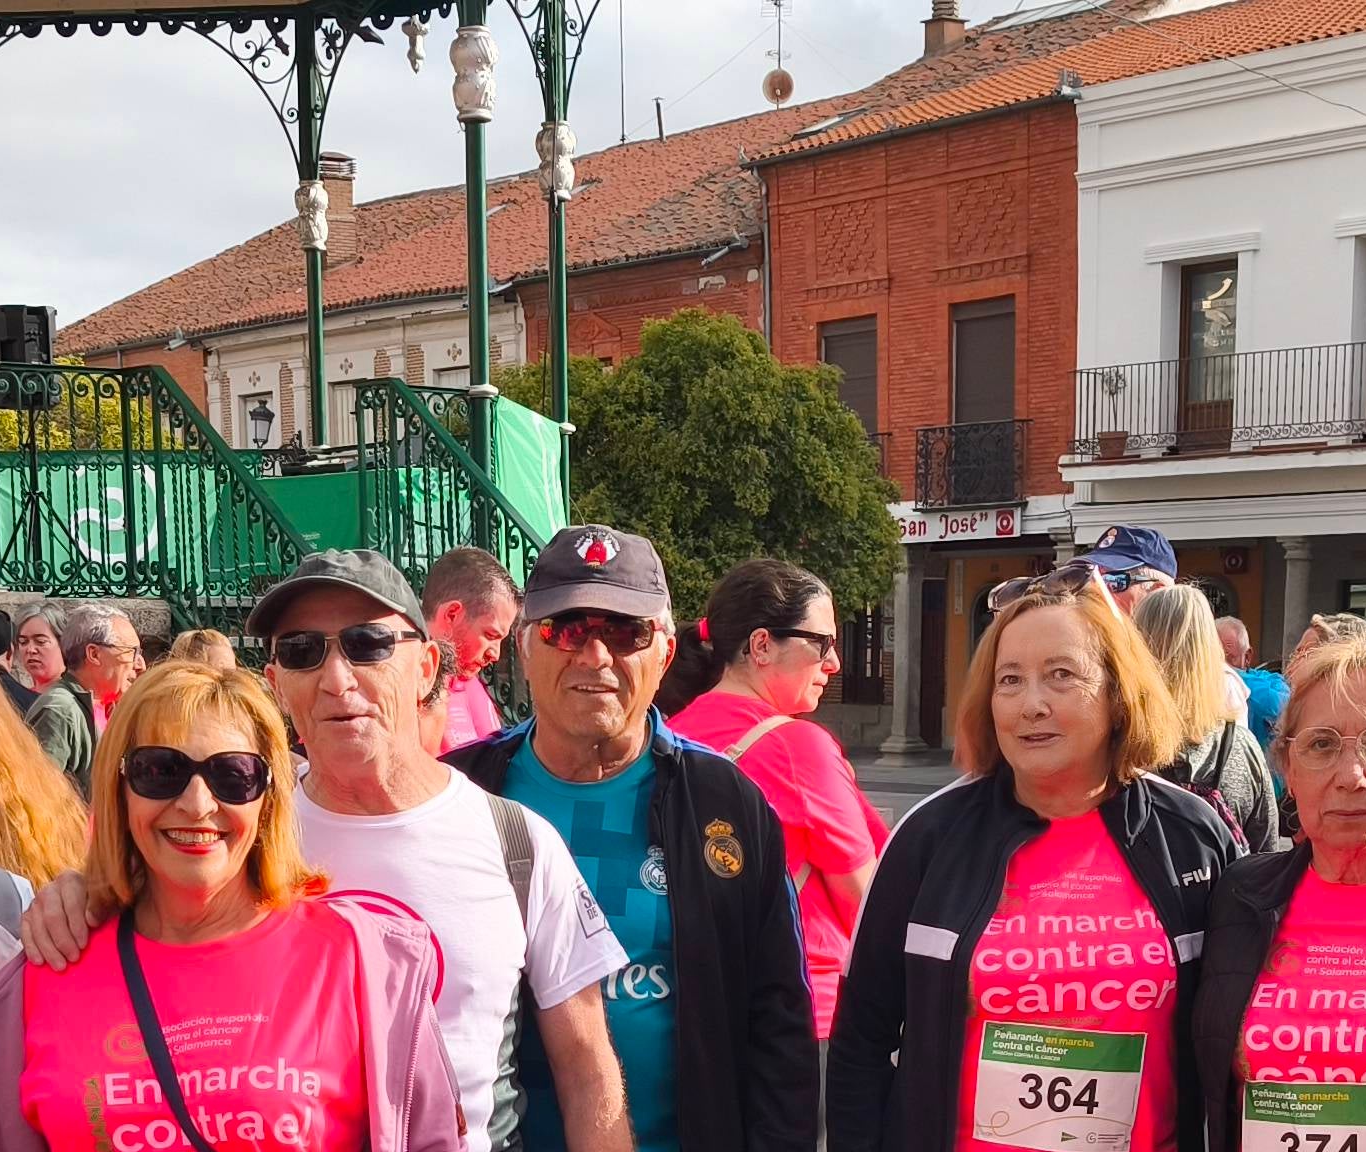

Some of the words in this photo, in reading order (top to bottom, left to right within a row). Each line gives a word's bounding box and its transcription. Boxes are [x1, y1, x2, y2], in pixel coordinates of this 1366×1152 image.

[983, 915, 1026, 936] En
[1038, 908, 1163, 934] march
[975, 940, 1135, 973] contra
[1142, 936, 1176, 968] el
[1306, 955, 1339, 964] contra
[1342, 956, 1352, 966] el
[1307, 944, 1363, 955] asociación
[1304, 966, 1317, 975] en
[980, 973, 1177, 1014] cáncer
[1251, 983, 1297, 1009] En
[992, 1040, 1023, 1051] contra
[1024, 1042, 1034, 1052] el
[1035, 1044, 1069, 1055] cáncer
[994, 1030, 1044, 1043] Peñaranda
[1045, 1036, 1058, 1044] en
[1059, 1038, 1095, 1048] marcha
[104, 1073, 163, 1106] En
[1019, 1073, 1100, 1115] 364
[1251, 1089, 1297, 1101] Peñaranda
[1299, 1093, 1311, 1102] en
[1313, 1092, 1350, 1101] marcha
[1254, 1099, 1280, 1109] contra
[1281, 1102, 1289, 1110] el
[1290, 1102, 1324, 1111] cáncer
[273, 1106, 312, 1147] el
